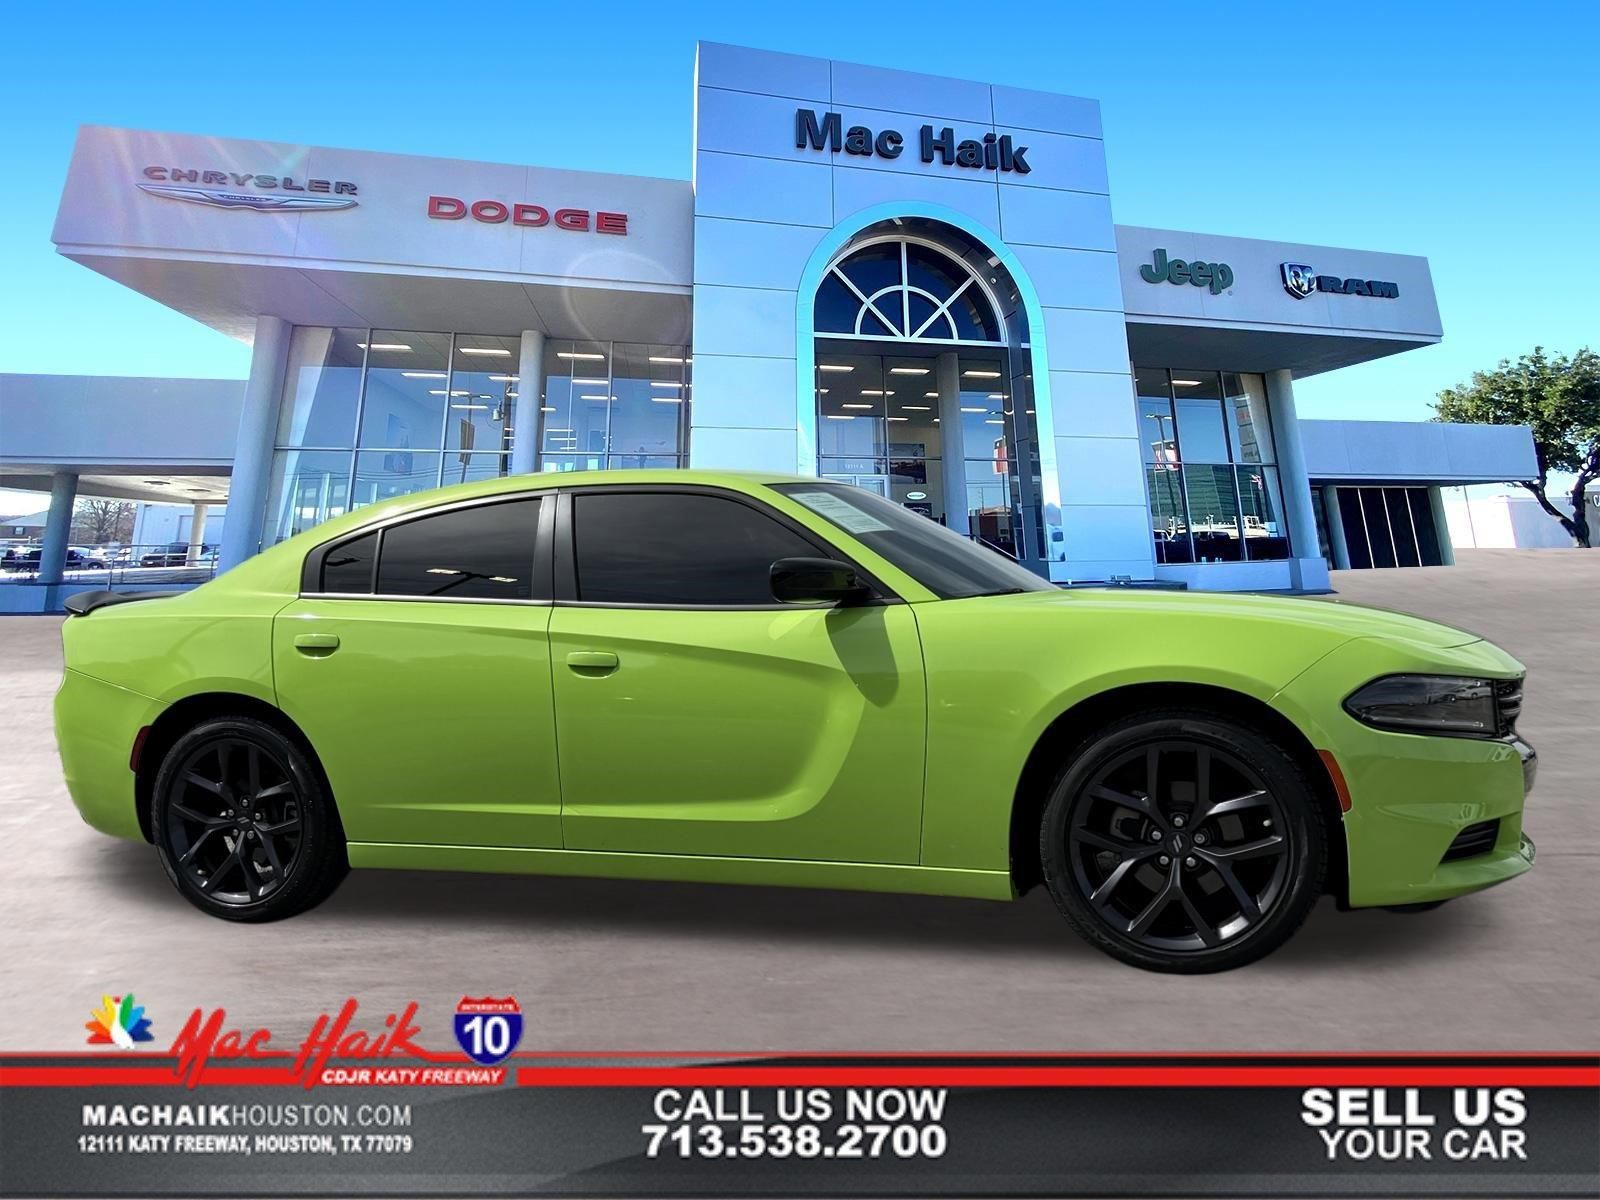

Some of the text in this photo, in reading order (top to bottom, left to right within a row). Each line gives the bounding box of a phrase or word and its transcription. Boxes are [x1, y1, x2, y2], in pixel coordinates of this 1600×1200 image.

[795, 108, 1032, 174] Mac Haik
[143, 166, 358, 196] CHRYSLER
[428, 195, 628, 236] DODGE
[1139, 248, 1234, 296] Jeep
[1315, 275, 1400, 299] RAM
